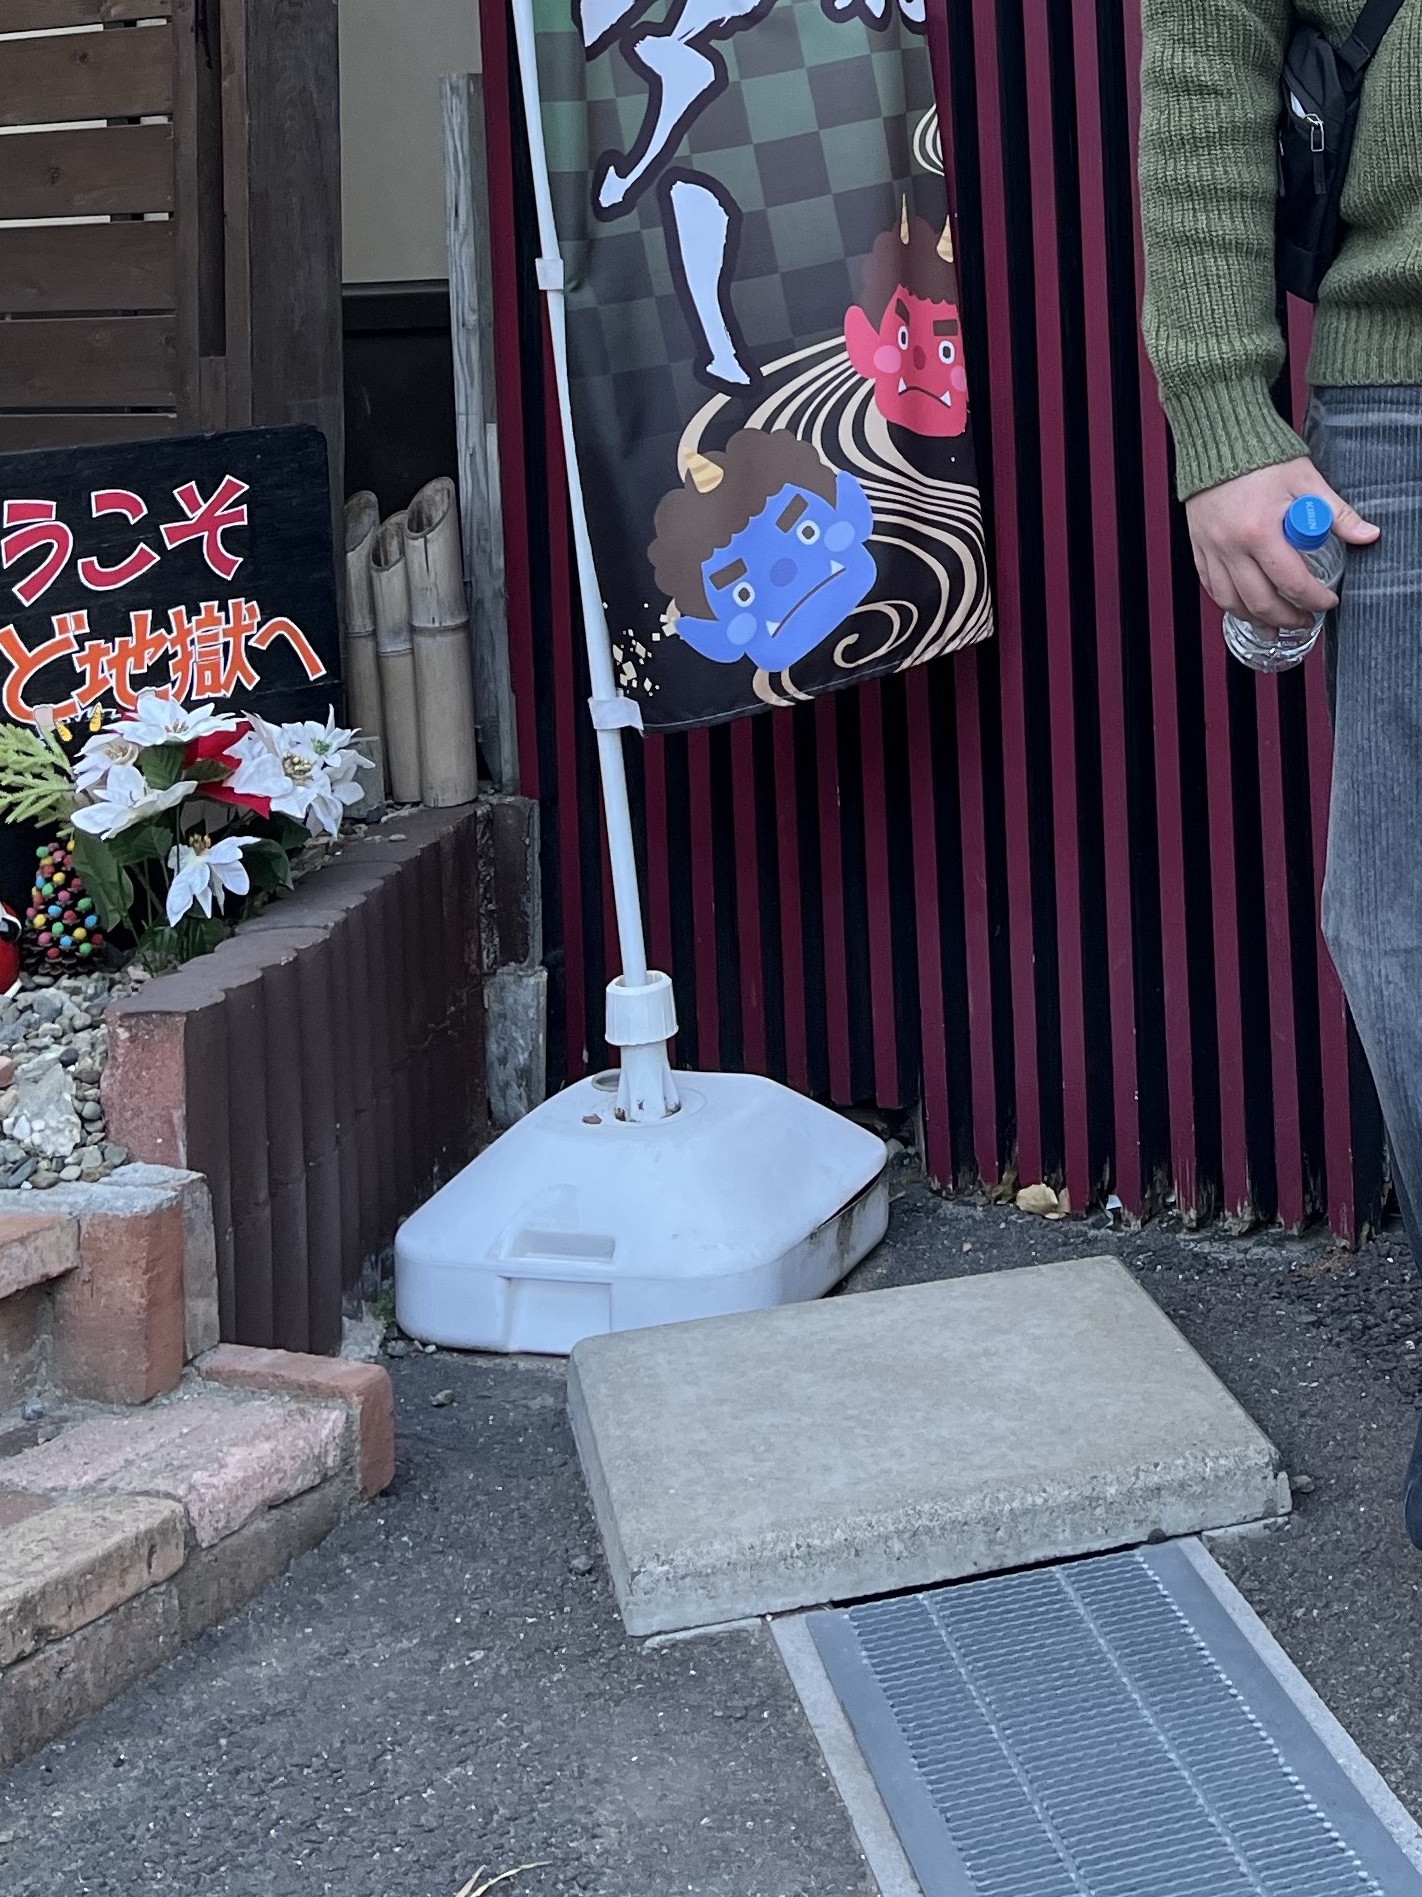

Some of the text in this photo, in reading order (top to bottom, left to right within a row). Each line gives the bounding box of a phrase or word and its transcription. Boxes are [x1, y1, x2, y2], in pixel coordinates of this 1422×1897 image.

[2, 474, 250, 607] うこそ
[0, 596, 327, 724] ど地獄へ
